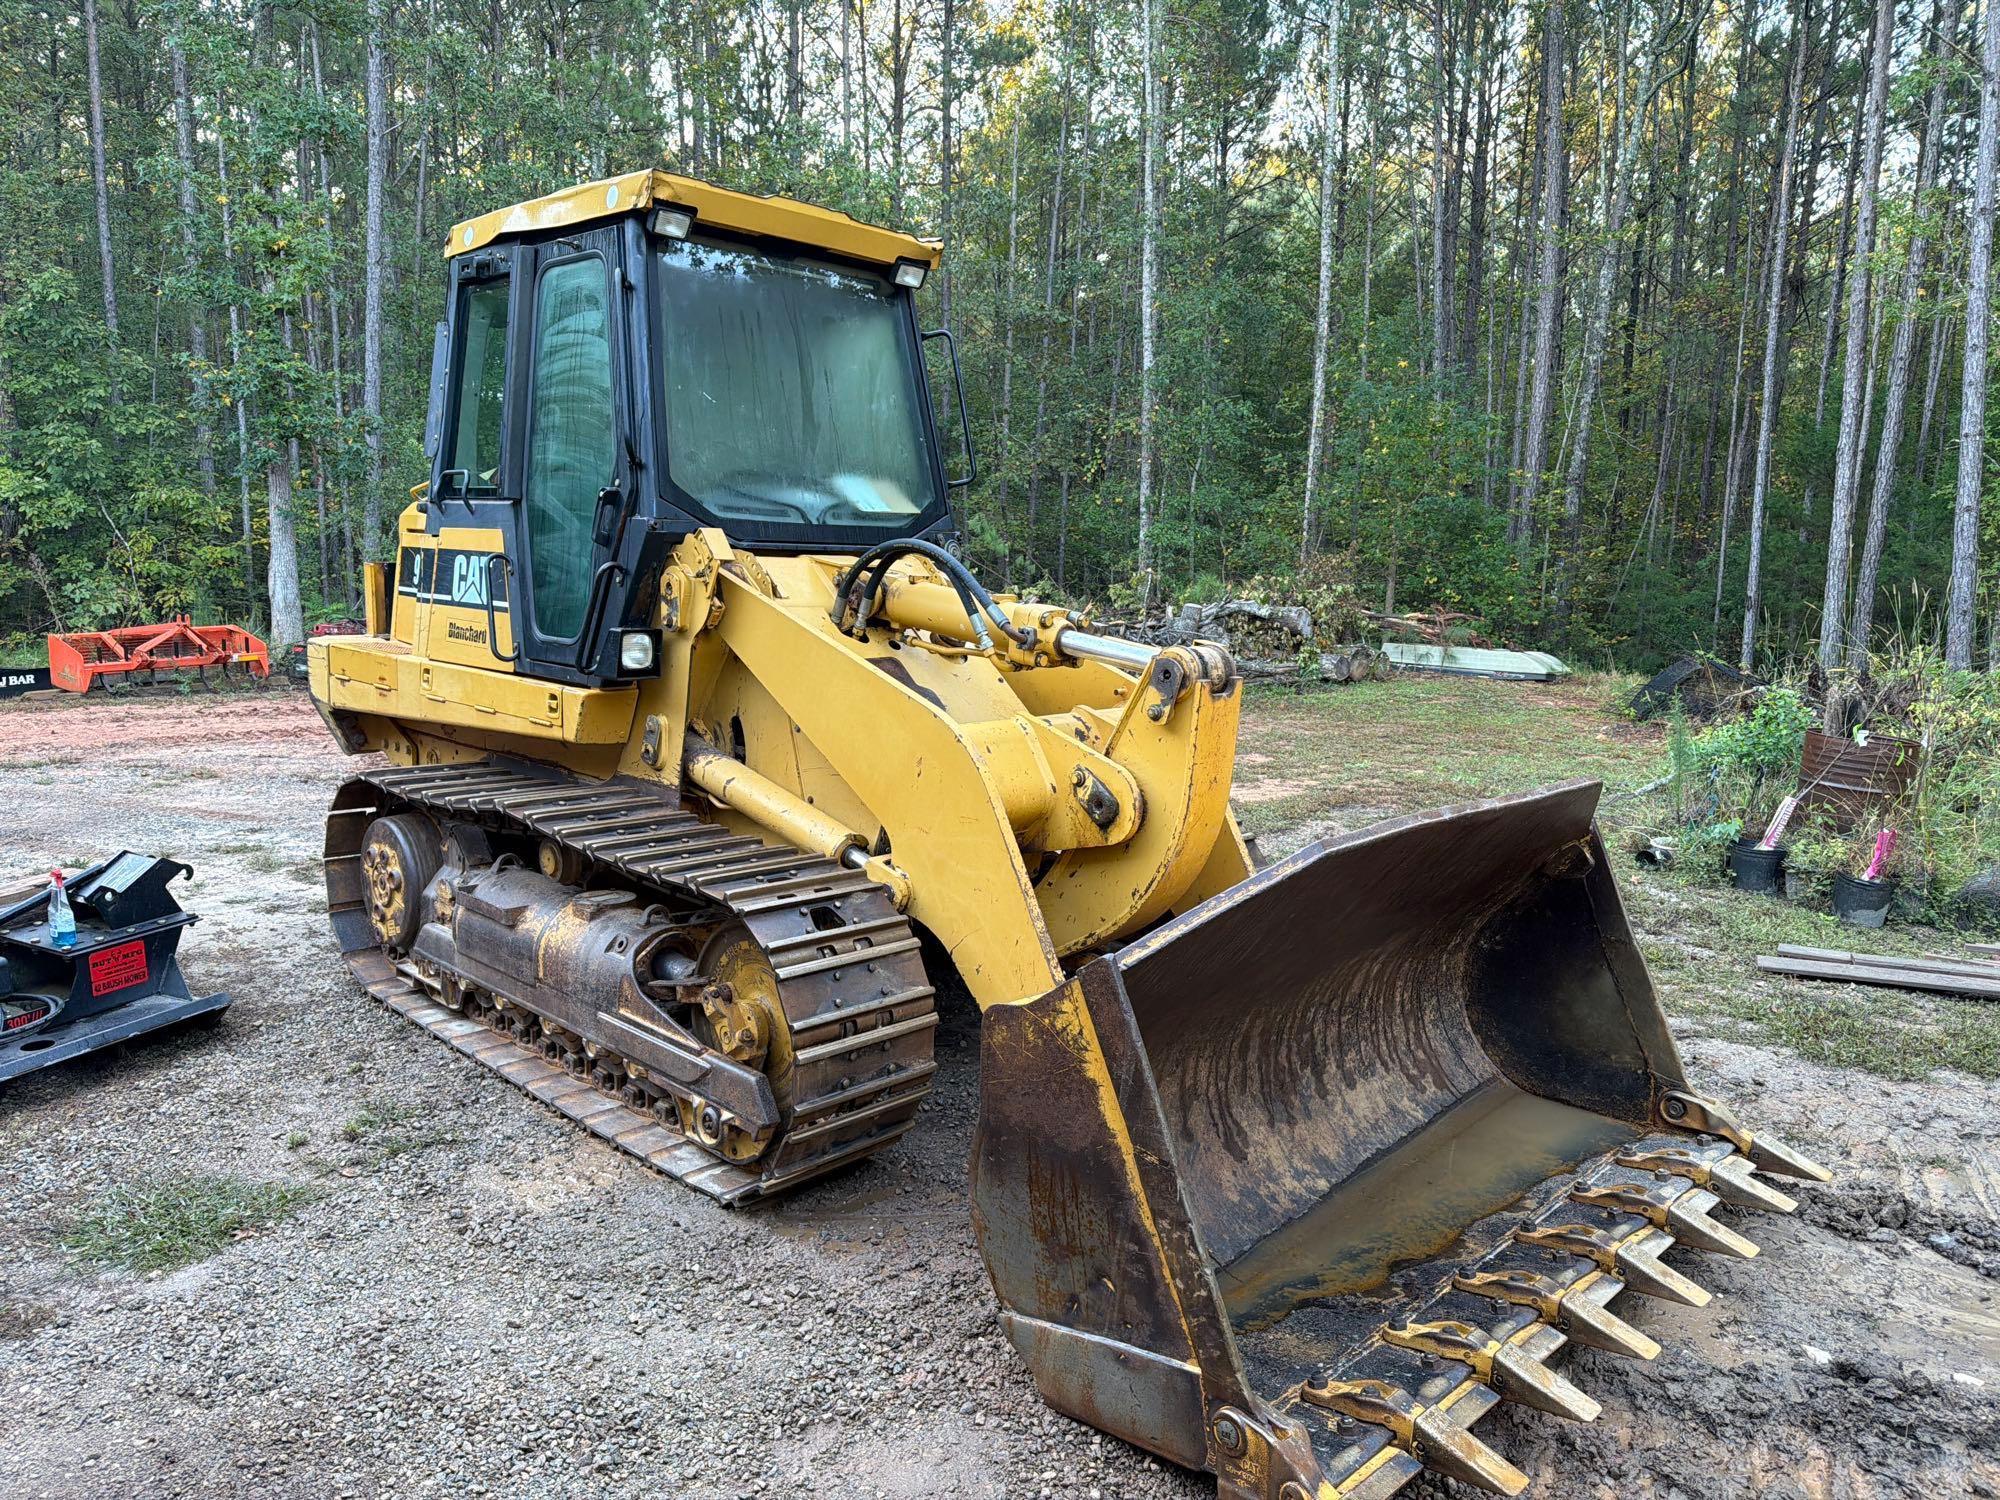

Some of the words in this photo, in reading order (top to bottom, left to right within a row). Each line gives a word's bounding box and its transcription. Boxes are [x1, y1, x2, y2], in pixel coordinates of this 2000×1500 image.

[452, 554, 496, 605] CAT
[448, 622, 487, 644] Blanchard
[8, 674, 36, 685] BAR
[102, 978, 123, 990] BRUSH
[124, 971, 146, 984] MOWER
